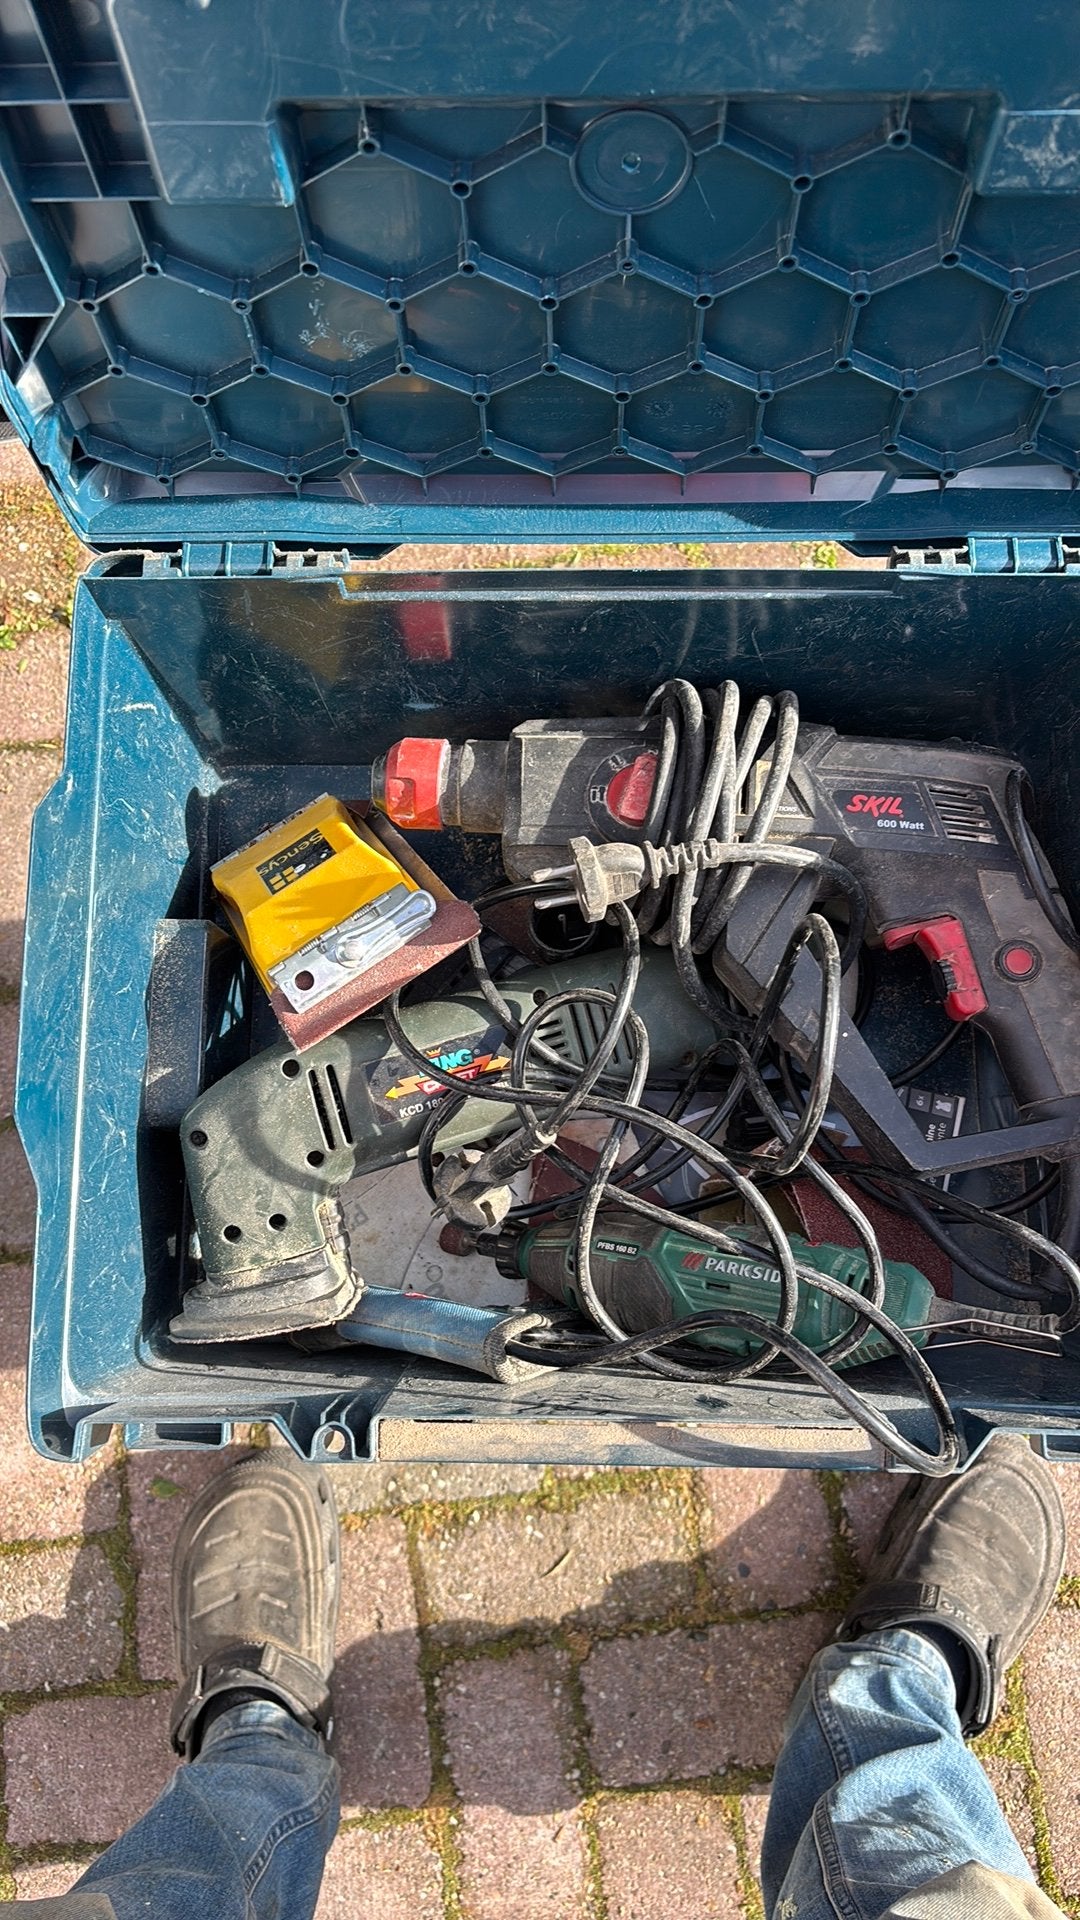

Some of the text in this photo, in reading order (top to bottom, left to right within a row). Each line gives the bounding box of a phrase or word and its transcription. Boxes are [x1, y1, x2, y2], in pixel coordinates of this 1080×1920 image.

[846, 794, 903, 818] SKIL
[877, 819, 925, 831] 600 Watt
[259, 832, 323, 876] Sencys
[399, 1103, 424, 1119] KCD
[596, 1241, 638, 1255] PFBS 160 B2
[704, 1257, 781, 1284] PARKSID
